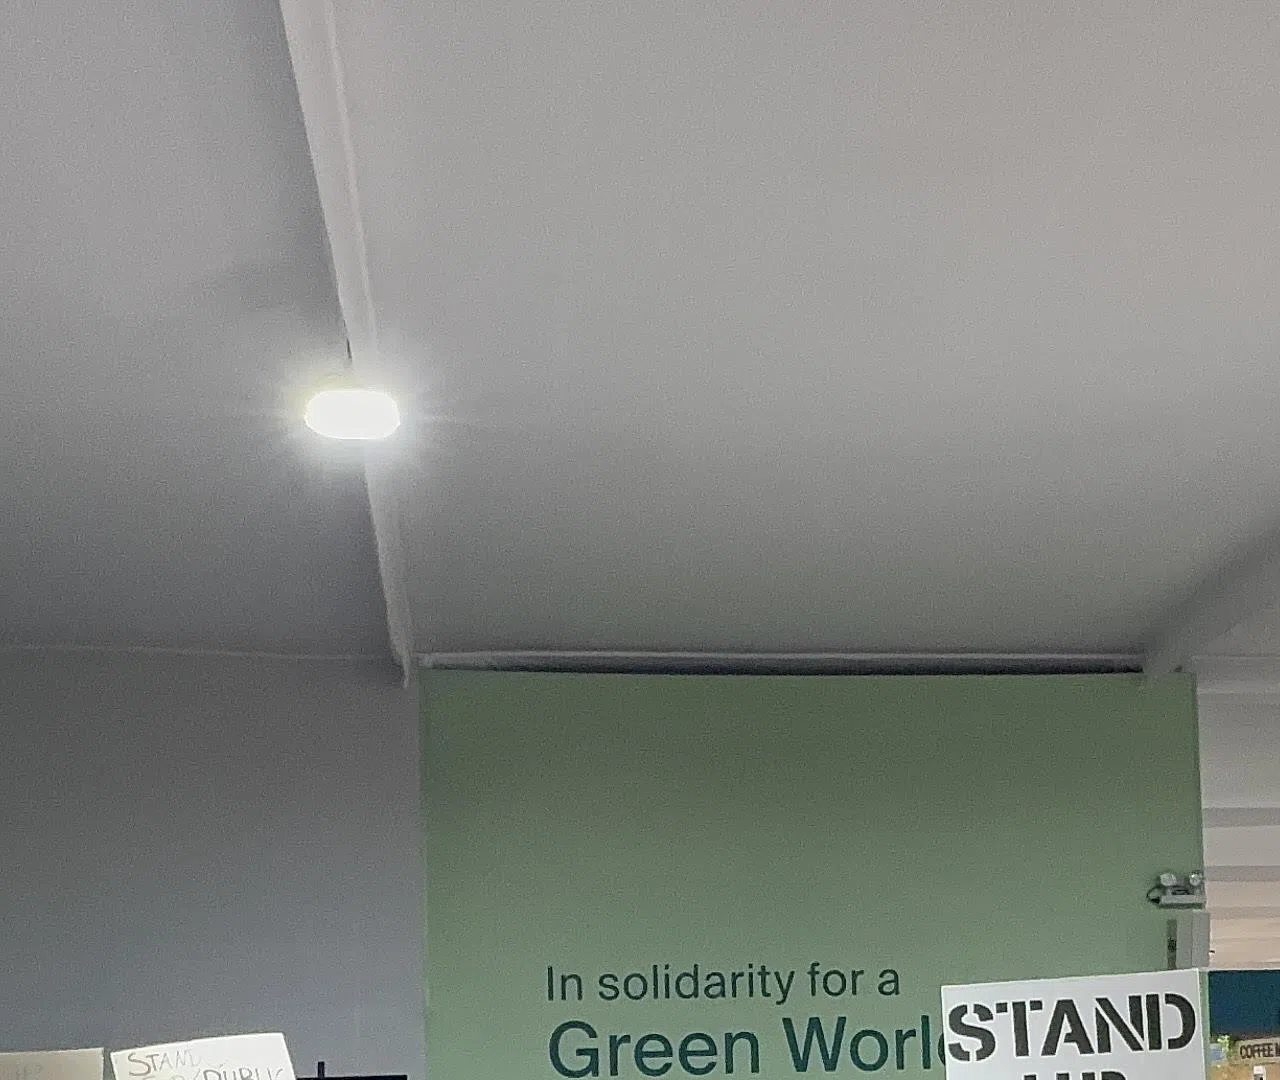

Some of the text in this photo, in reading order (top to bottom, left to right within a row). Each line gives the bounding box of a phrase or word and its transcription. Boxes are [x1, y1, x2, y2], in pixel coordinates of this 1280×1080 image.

[547, 962, 900, 1006] In solidarity for a
[549, 1014, 945, 1079] Green Worl
[948, 993, 1196, 1062] STAND
[127, 1049, 201, 1077] STAND
[1240, 1042, 1273, 1060] COFFEE
